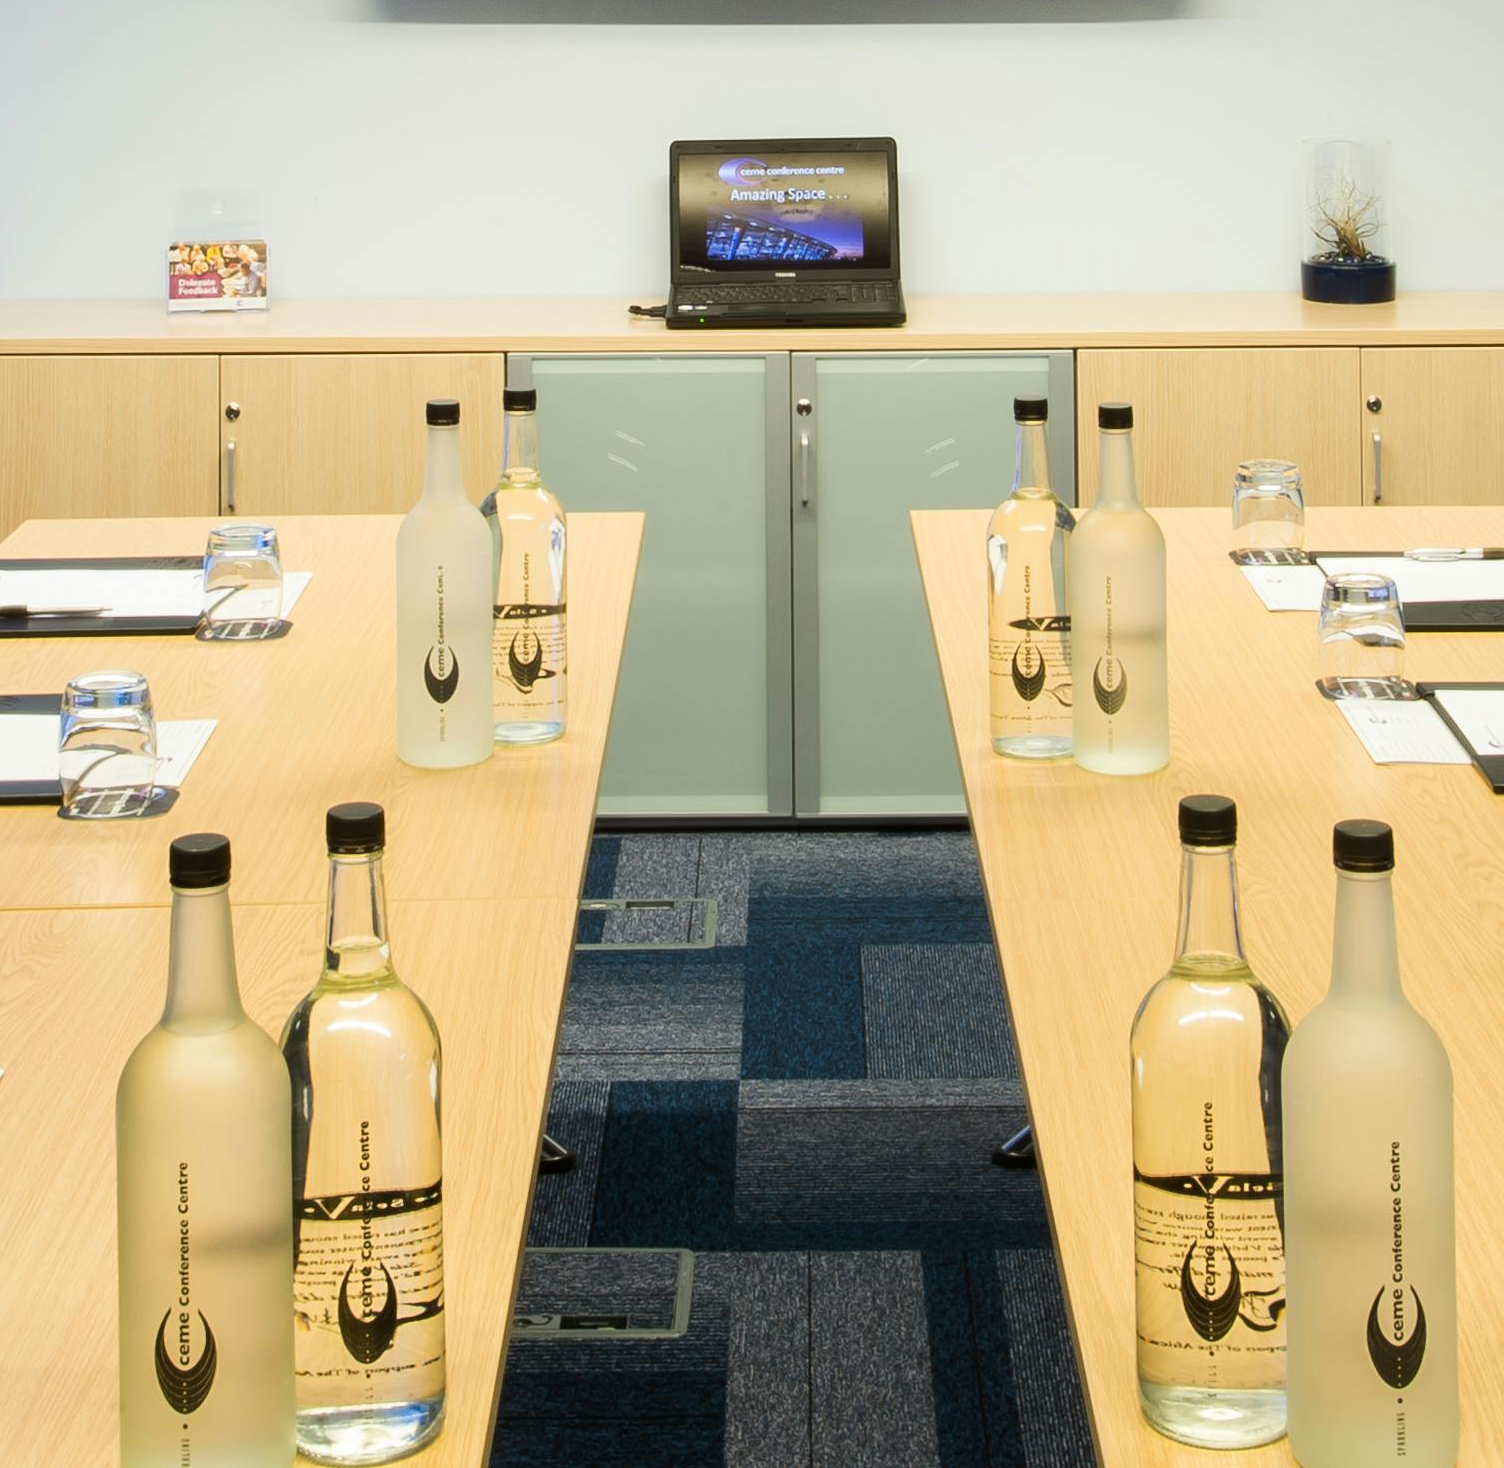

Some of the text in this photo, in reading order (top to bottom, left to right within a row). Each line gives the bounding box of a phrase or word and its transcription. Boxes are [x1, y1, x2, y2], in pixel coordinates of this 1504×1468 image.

[730, 188, 785, 202] Amazing
[788, 188, 825, 202] Space
[766, 165, 815, 177] conference
[816, 165, 845, 176] centre
[178, 278, 216, 289] Delegate
[178, 287, 219, 295] Feedback
[437, 597, 445, 644] Conference
[358, 1120, 371, 1171] Centre
[1202, 1101, 1214, 1152] Centre
[177, 1163, 191, 1366] ceme Conference Centre
[1389, 1141, 1404, 1342] ceme Conference Centre
[360, 1266, 374, 1319] ceme
[1203, 1245, 1217, 1297] ceme
